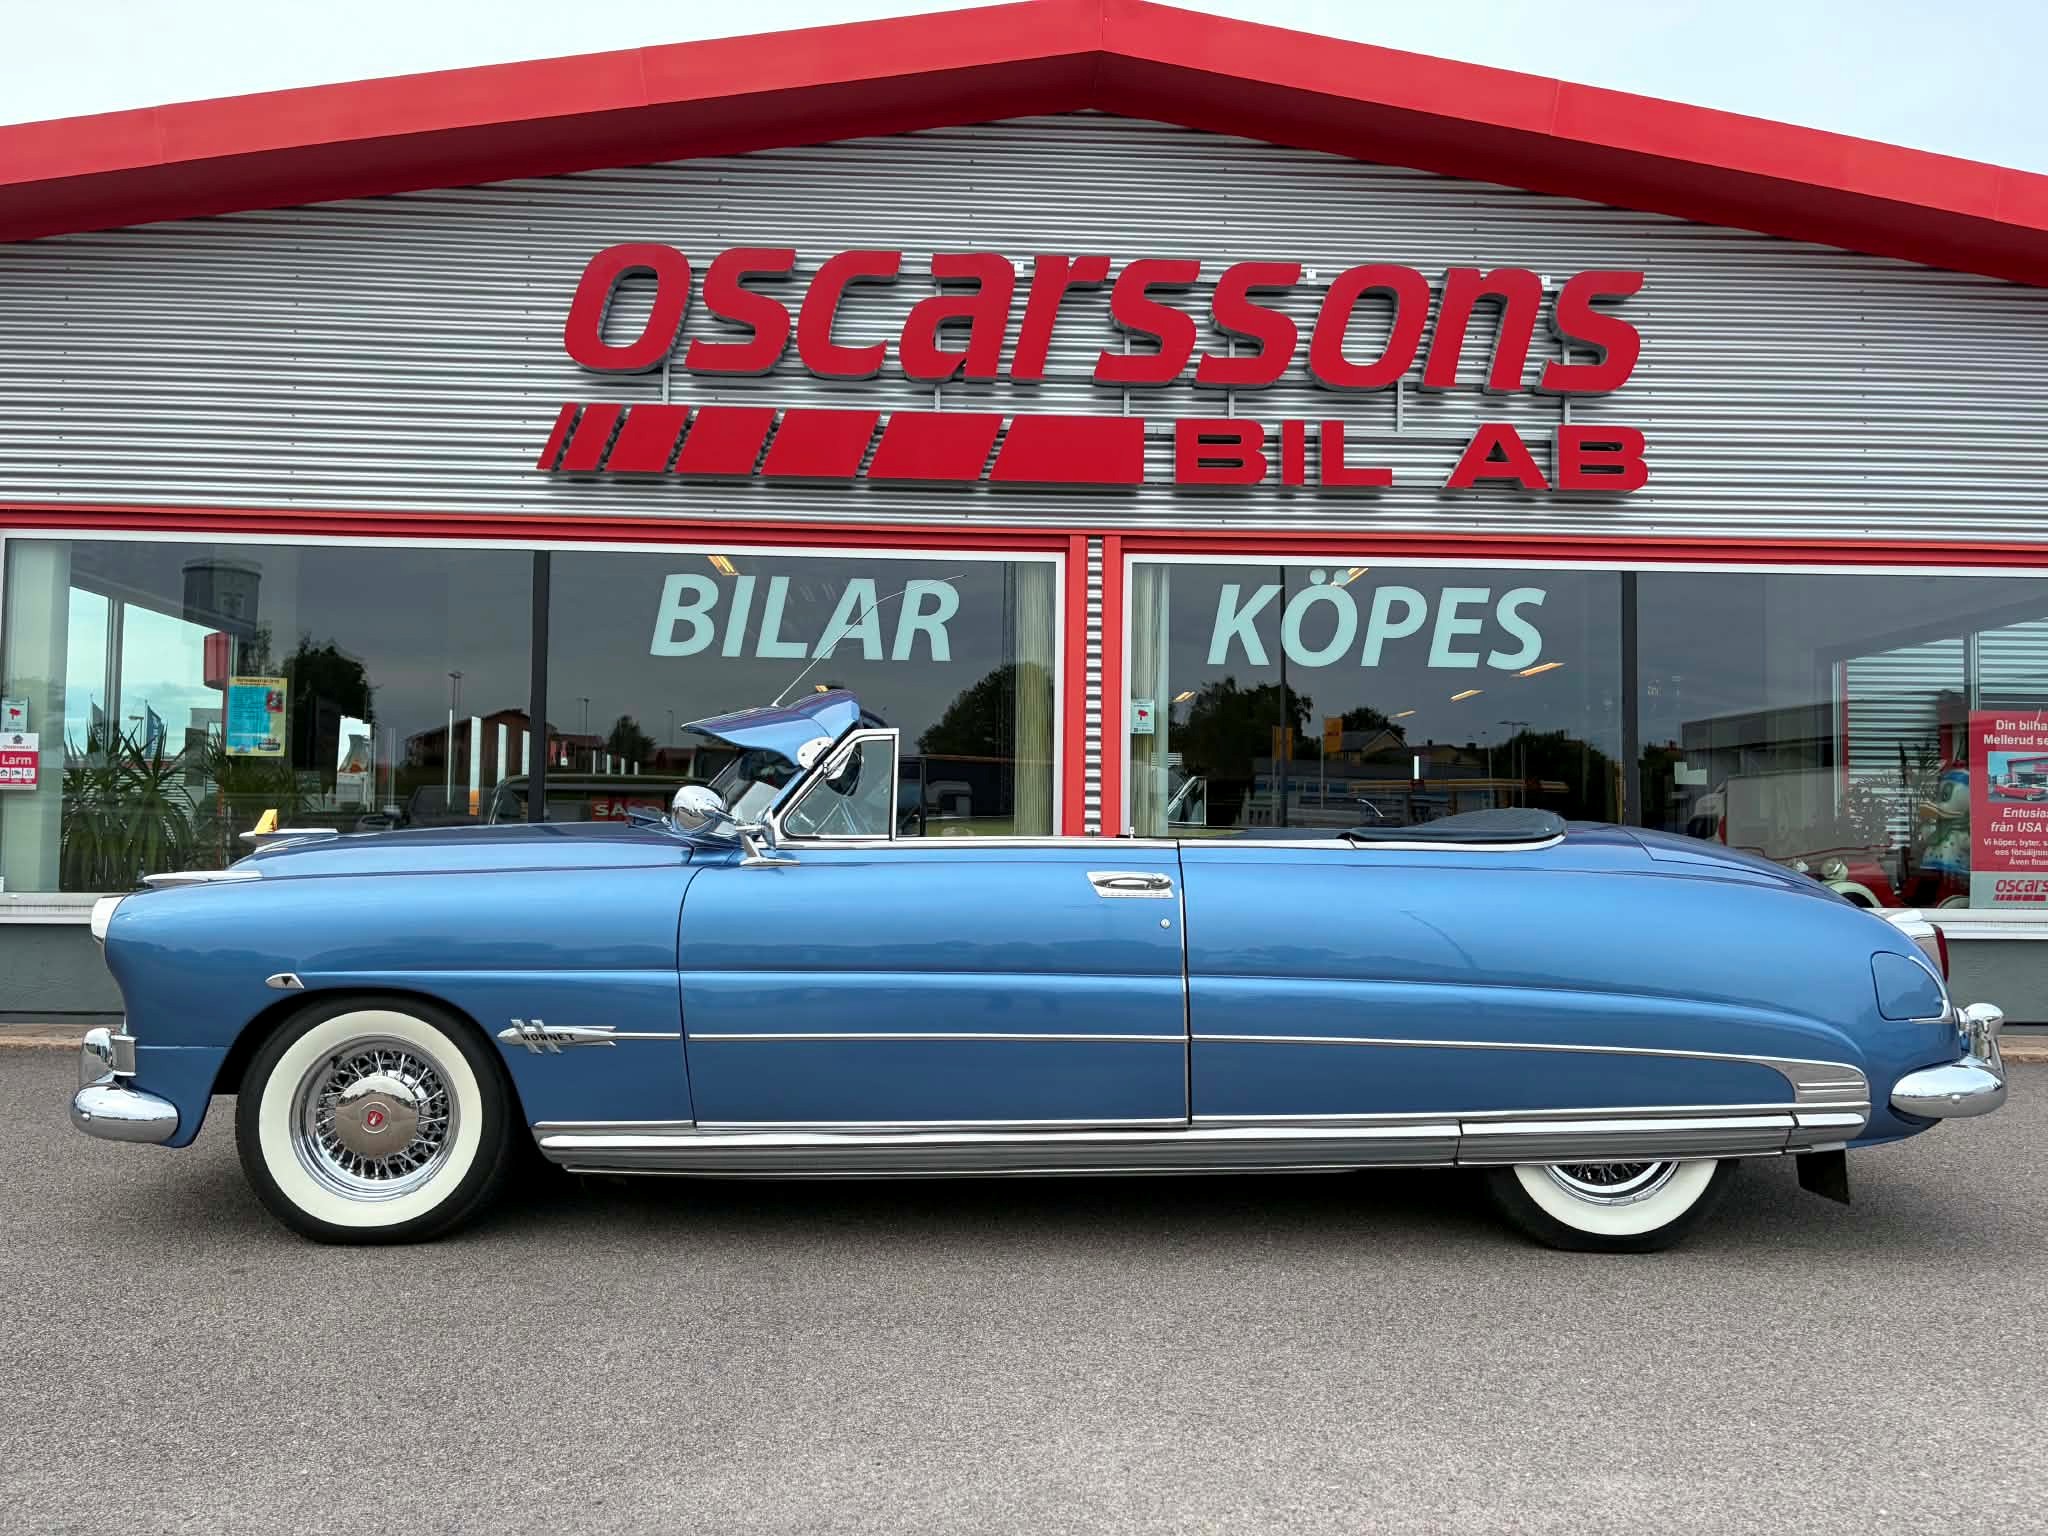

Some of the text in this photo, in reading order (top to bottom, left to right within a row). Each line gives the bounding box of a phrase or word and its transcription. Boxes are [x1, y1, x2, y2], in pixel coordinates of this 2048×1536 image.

[1174, 418, 1649, 493] BIL AB
[649, 573, 961, 663] BILAR
[1207, 568, 1547, 671] KÖPES
[1996, 719, 2016, 730] Din
[1983, 734, 2034, 745] Mellerud
[1, 753, 32, 765] Larm
[1990, 821, 2014, 832] från
[2017, 822, 2043, 832] USA
[1983, 838, 1991, 846] Vi
